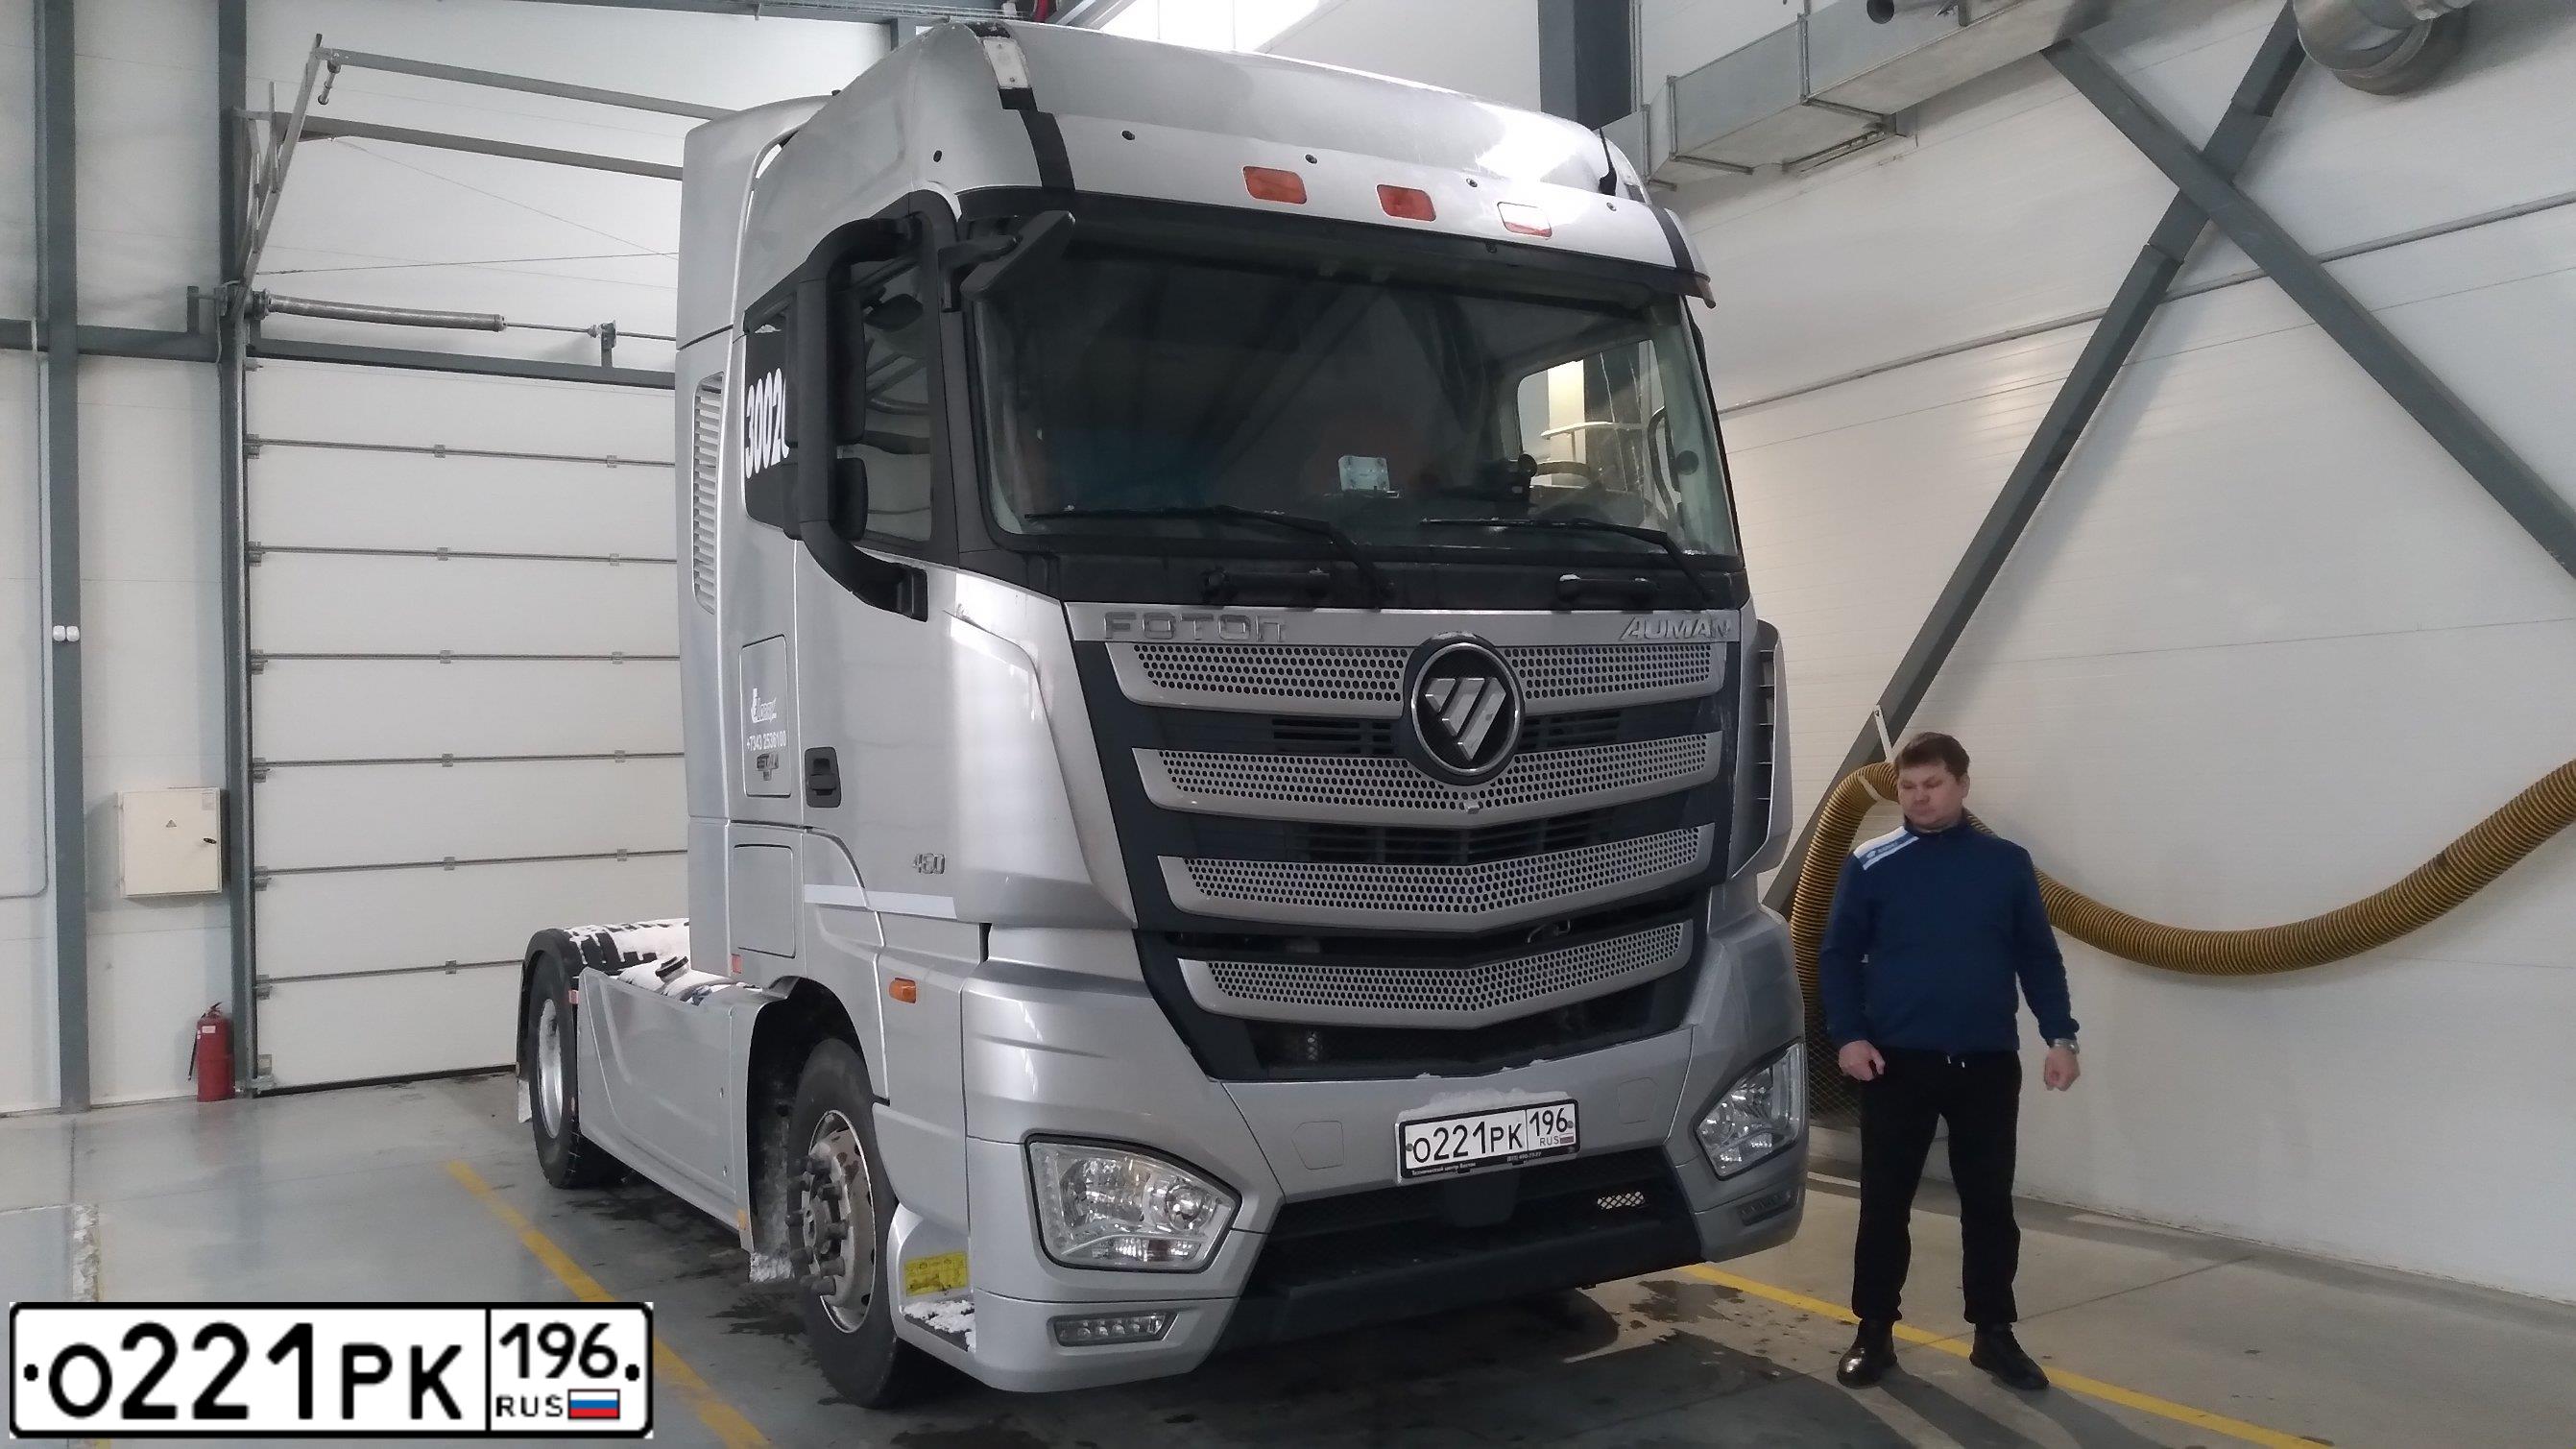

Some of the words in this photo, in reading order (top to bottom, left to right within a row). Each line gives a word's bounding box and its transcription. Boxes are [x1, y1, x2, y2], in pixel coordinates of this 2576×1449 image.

[1619, 616, 1731, 641] AUMAN
[1529, 1108, 1568, 1137] 196
[1539, 1135, 1560, 1147] RUS
